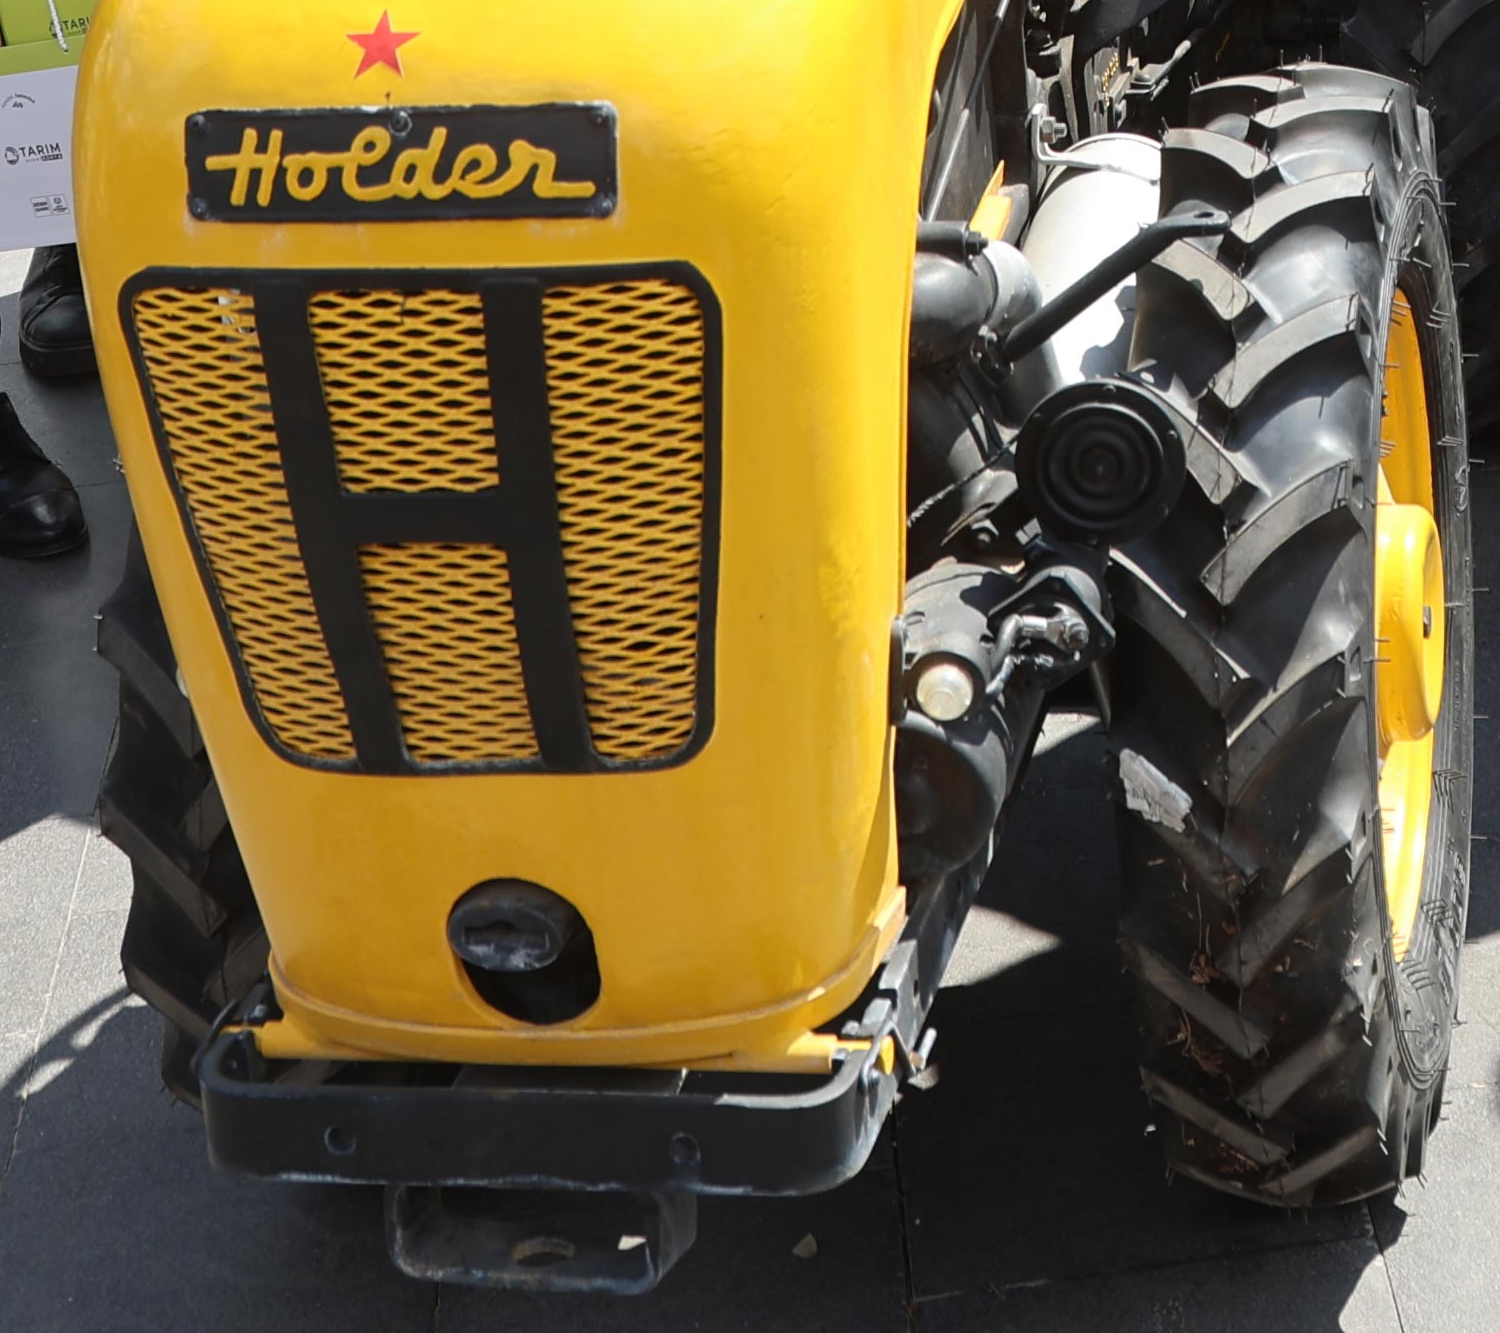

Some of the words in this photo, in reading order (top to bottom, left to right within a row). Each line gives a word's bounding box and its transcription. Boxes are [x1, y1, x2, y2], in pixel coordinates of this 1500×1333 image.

[62, 17, 91, 31] TARI
[18, 142, 62, 158] TARIM
[204, 125, 597, 207] Holder
